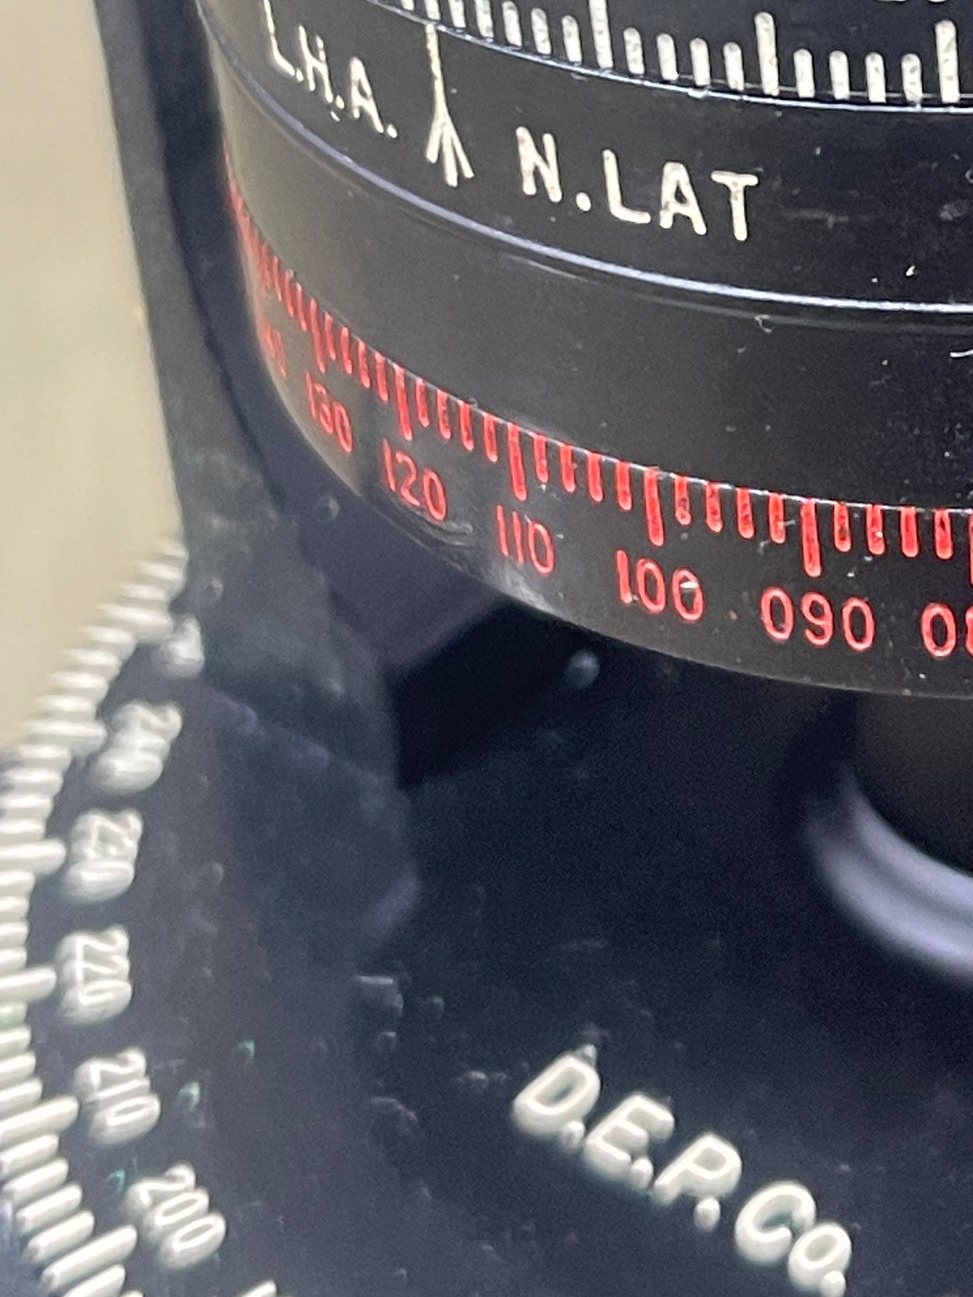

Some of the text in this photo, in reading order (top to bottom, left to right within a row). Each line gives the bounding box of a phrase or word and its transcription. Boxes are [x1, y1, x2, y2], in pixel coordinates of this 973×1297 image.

[304, 370, 354, 454] 130
[383, 439, 447, 522] 120
[496, 505, 556, 577] 110
[615, 549, 706, 622] 100
[760, 586, 877, 653] 090
[58, 924, 134, 1024] 220
[74, 1046, 162, 1147] 210
[125, 1161, 228, 1272] 200
